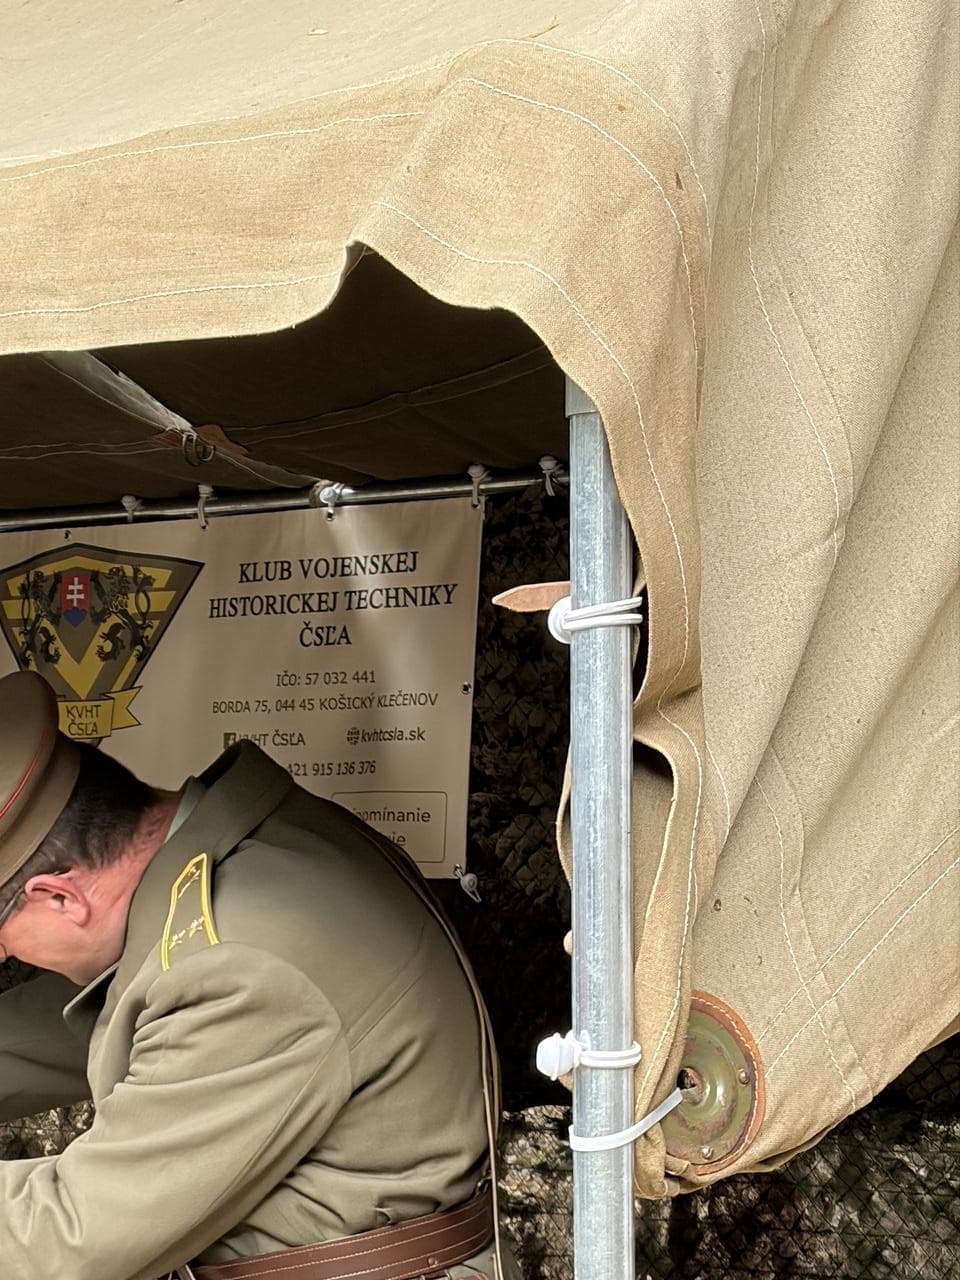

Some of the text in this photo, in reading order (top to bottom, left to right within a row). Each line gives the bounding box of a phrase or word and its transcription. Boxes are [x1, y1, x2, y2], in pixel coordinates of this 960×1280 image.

[239, 551, 418, 583] KLUB VOJENSKEJ
[208, 583, 458, 618] HISTORICKEJ TECHNIKY
[299, 621, 352, 647] ČSĽA
[276, 670, 375, 687] IČO: 57 032 441
[212, 690, 438, 714] BORDA 75, 044 45 KOŠICKÝ KLEČENOV
[65, 704, 101, 719] KVHT
[68, 719, 98, 736] ČSĽA
[361, 727, 426, 743] kvhtcsla.sk
[272, 729, 306, 746] ČSĽA
[312, 762, 333, 775] 915
[336, 762, 355, 774] 136
[358, 760, 376, 774] 376
